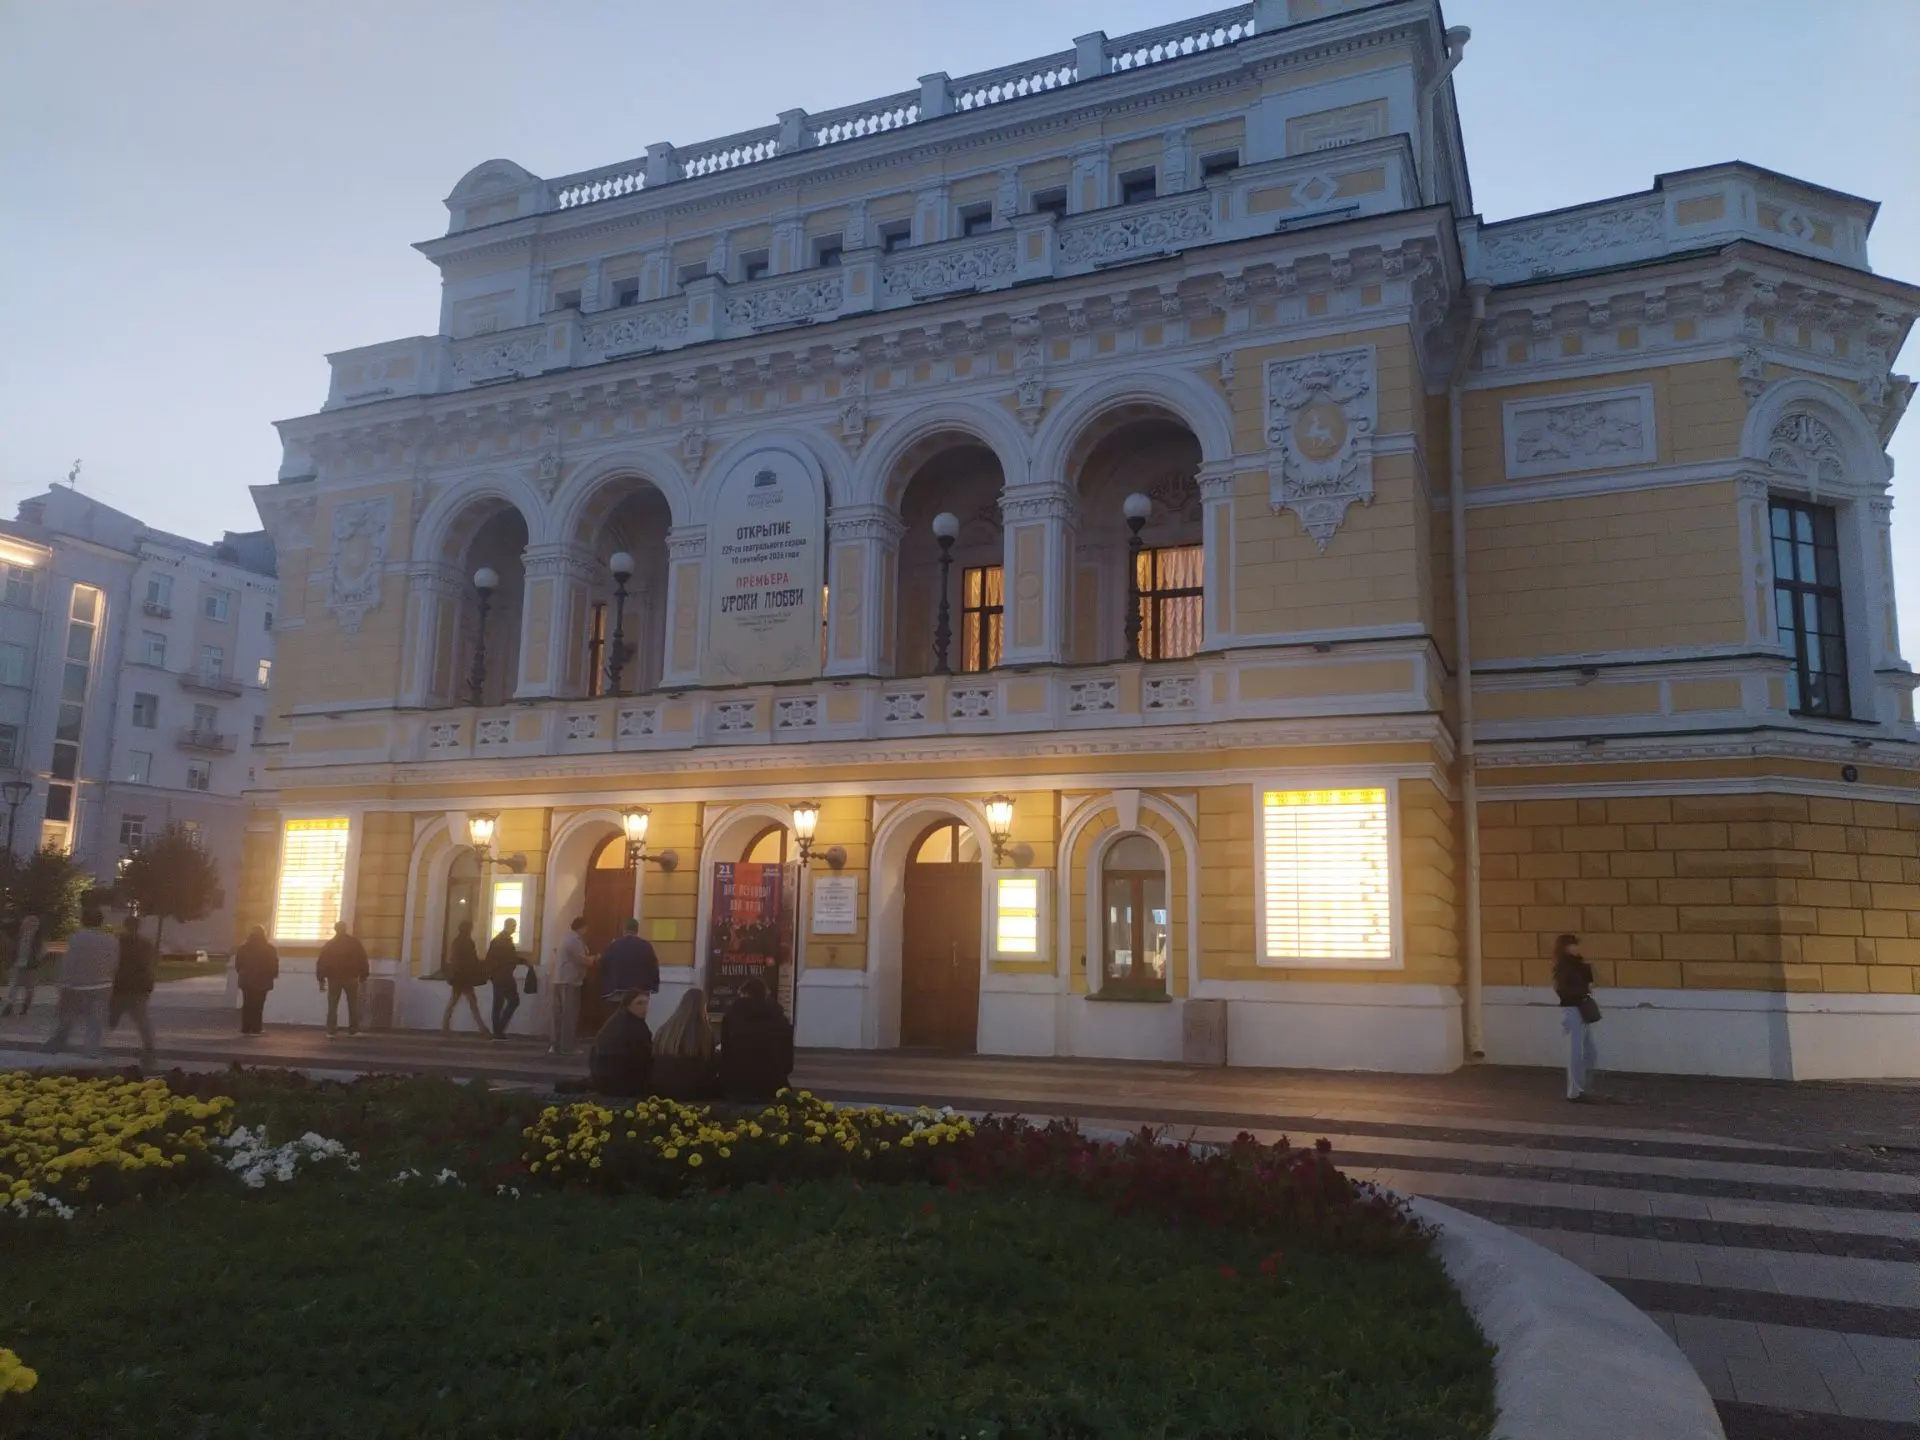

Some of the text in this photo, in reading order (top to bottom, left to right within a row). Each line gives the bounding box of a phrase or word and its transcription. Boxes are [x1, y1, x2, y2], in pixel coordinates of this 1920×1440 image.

[736, 520, 791, 541] ОТКРЫТИЕ
[736, 572, 789, 588] ПРЕМЬЕРА
[721, 588, 804, 613] УРОКИ ЛЮБВИ
[719, 865, 731, 874] 21
